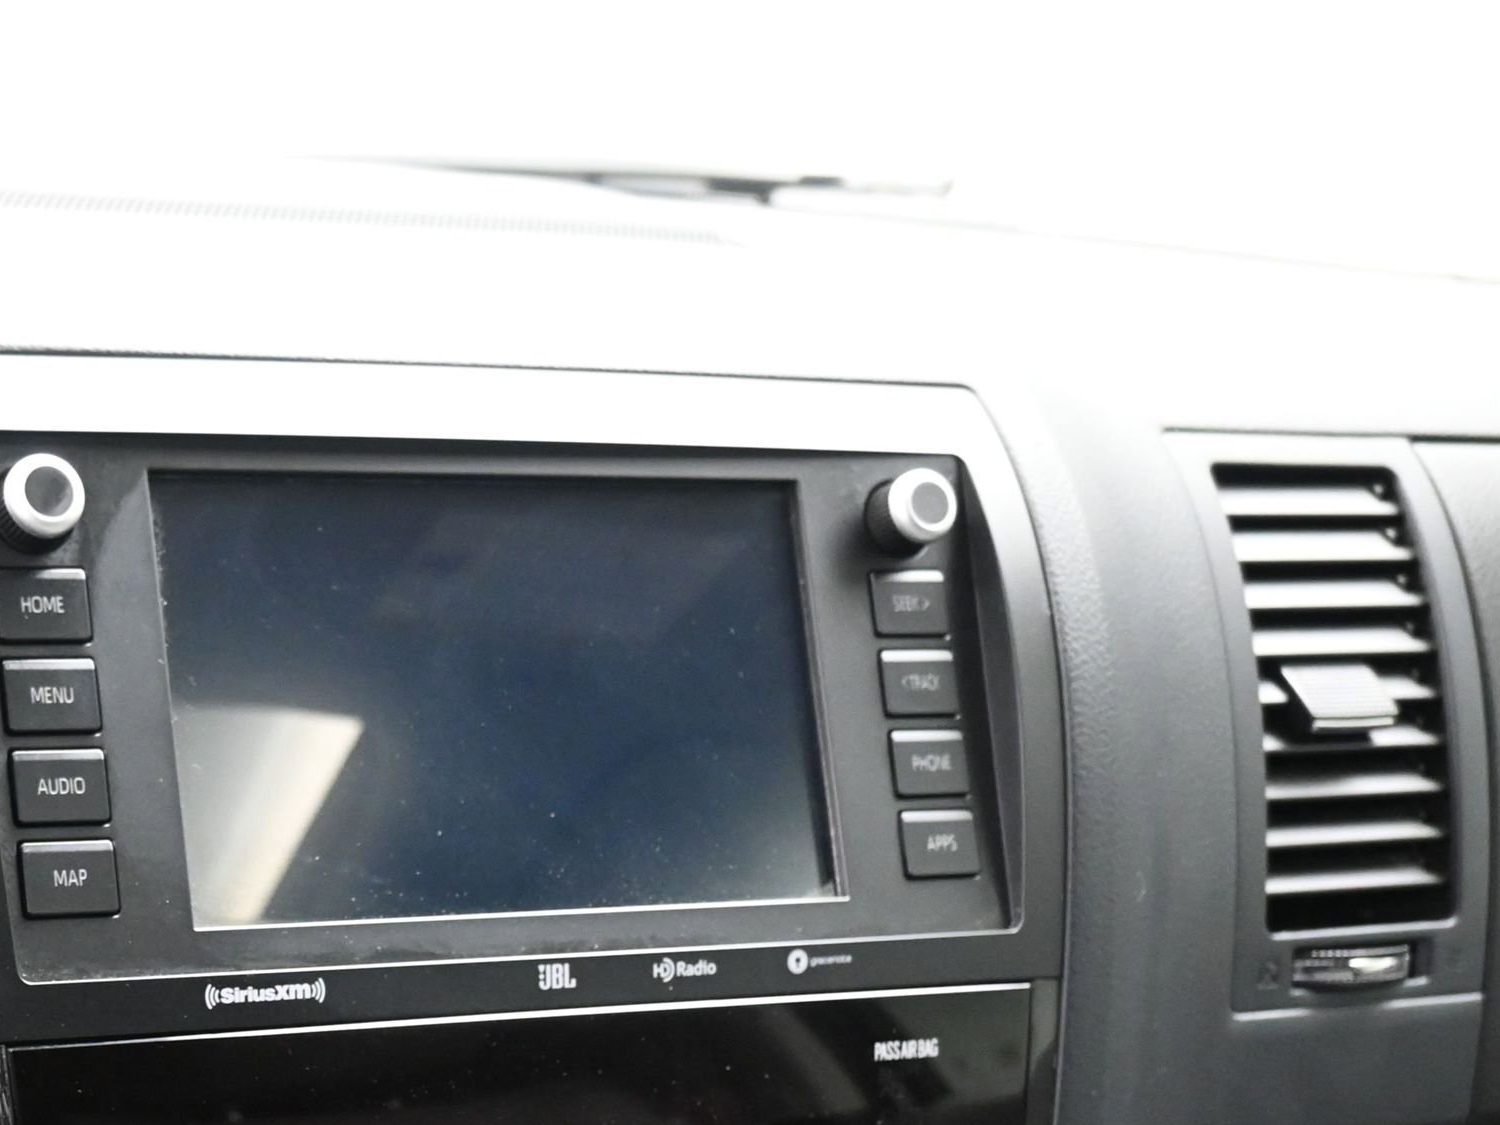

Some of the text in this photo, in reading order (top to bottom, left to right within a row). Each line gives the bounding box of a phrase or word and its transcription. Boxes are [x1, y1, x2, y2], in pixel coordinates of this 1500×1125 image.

[20, 596, 65, 615] HOME
[30, 687, 75, 705] MENU
[911, 755, 951, 772] PHONE
[37, 776, 86, 796] AUDIO
[927, 834, 958, 853] APPS
[53, 870, 88, 889] MAP
[538, 962, 577, 990] JBL
[676, 960, 717, 977] Radio
